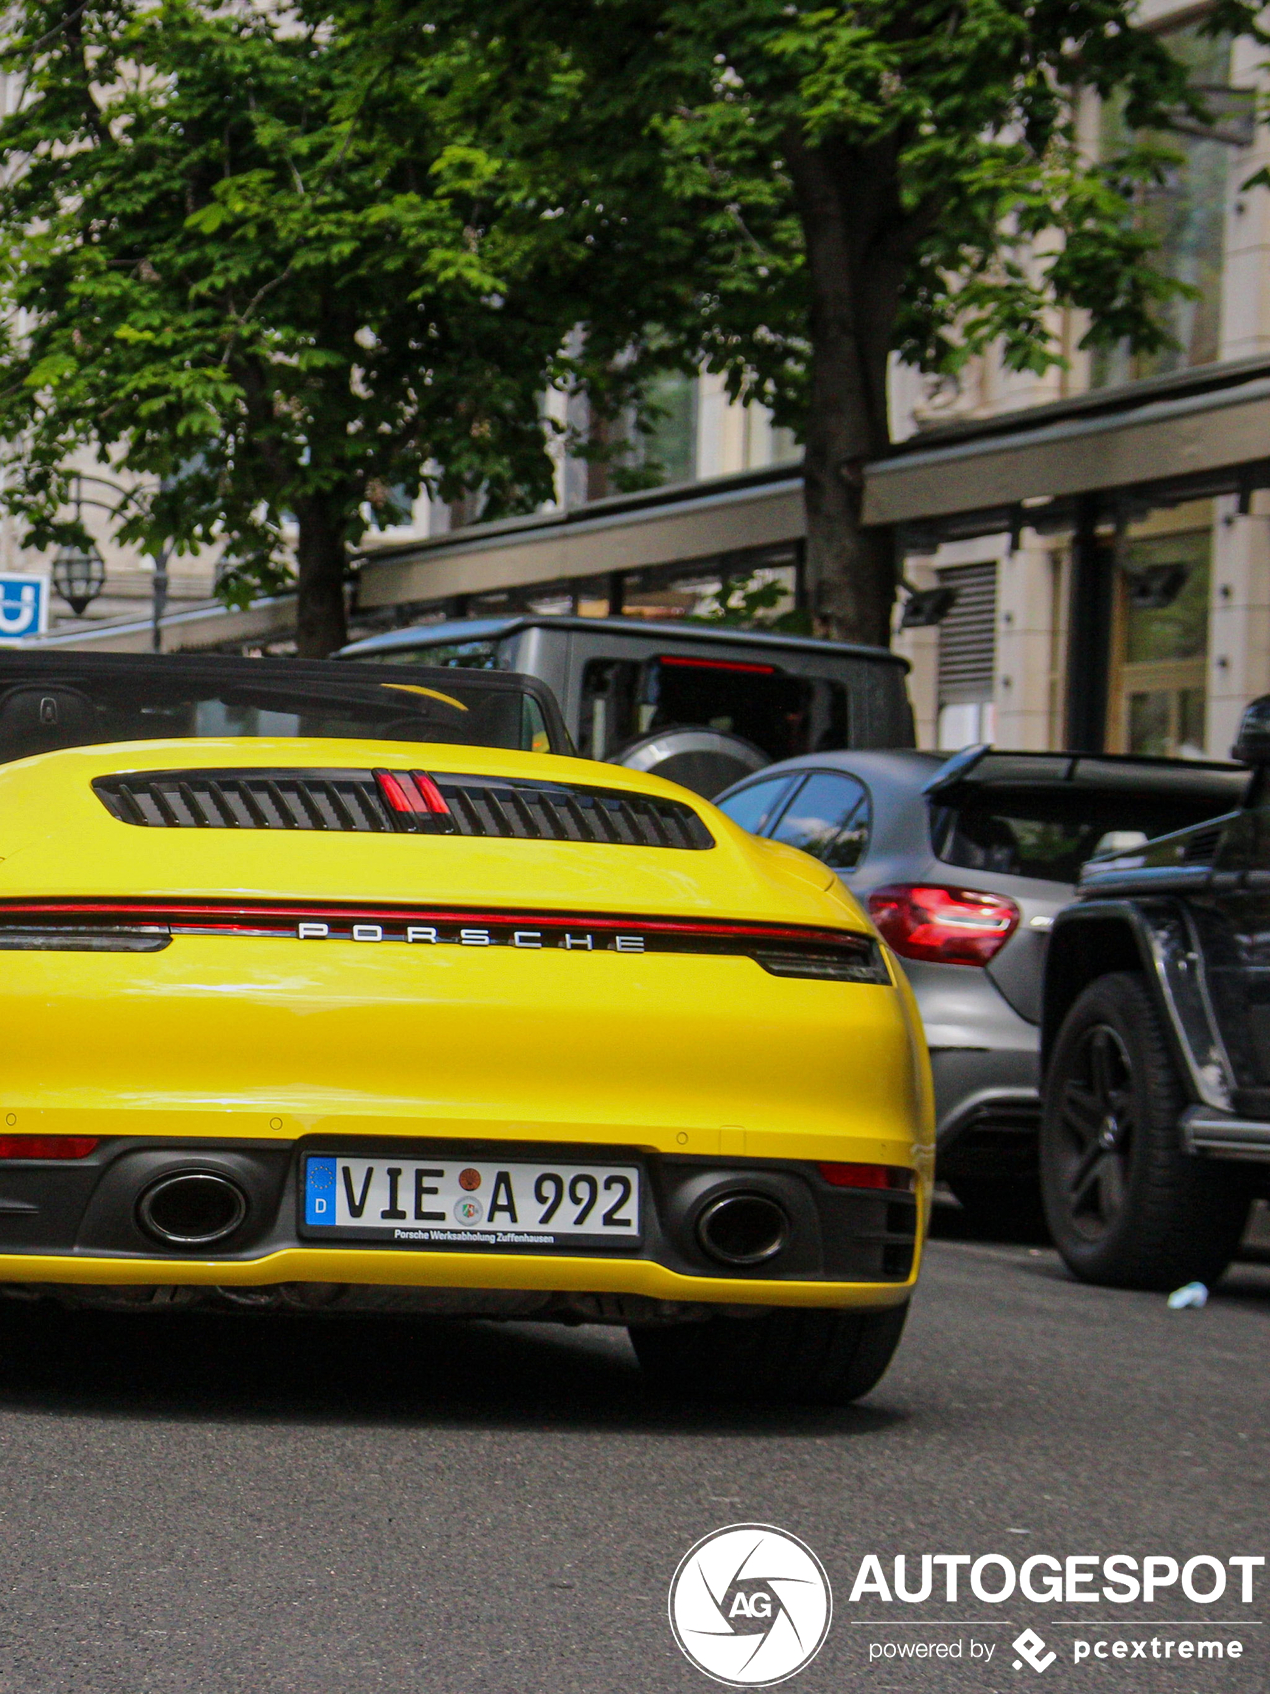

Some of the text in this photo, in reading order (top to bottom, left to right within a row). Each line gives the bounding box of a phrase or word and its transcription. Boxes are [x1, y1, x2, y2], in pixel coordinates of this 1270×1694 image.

[297, 922, 645, 953] PORSCHE
[314, 1197, 327, 1214] D
[341, 1165, 633, 1228] VIE A 992
[394, 1229, 554, 1245] Porsche Werksabholung Zuffenhausen
